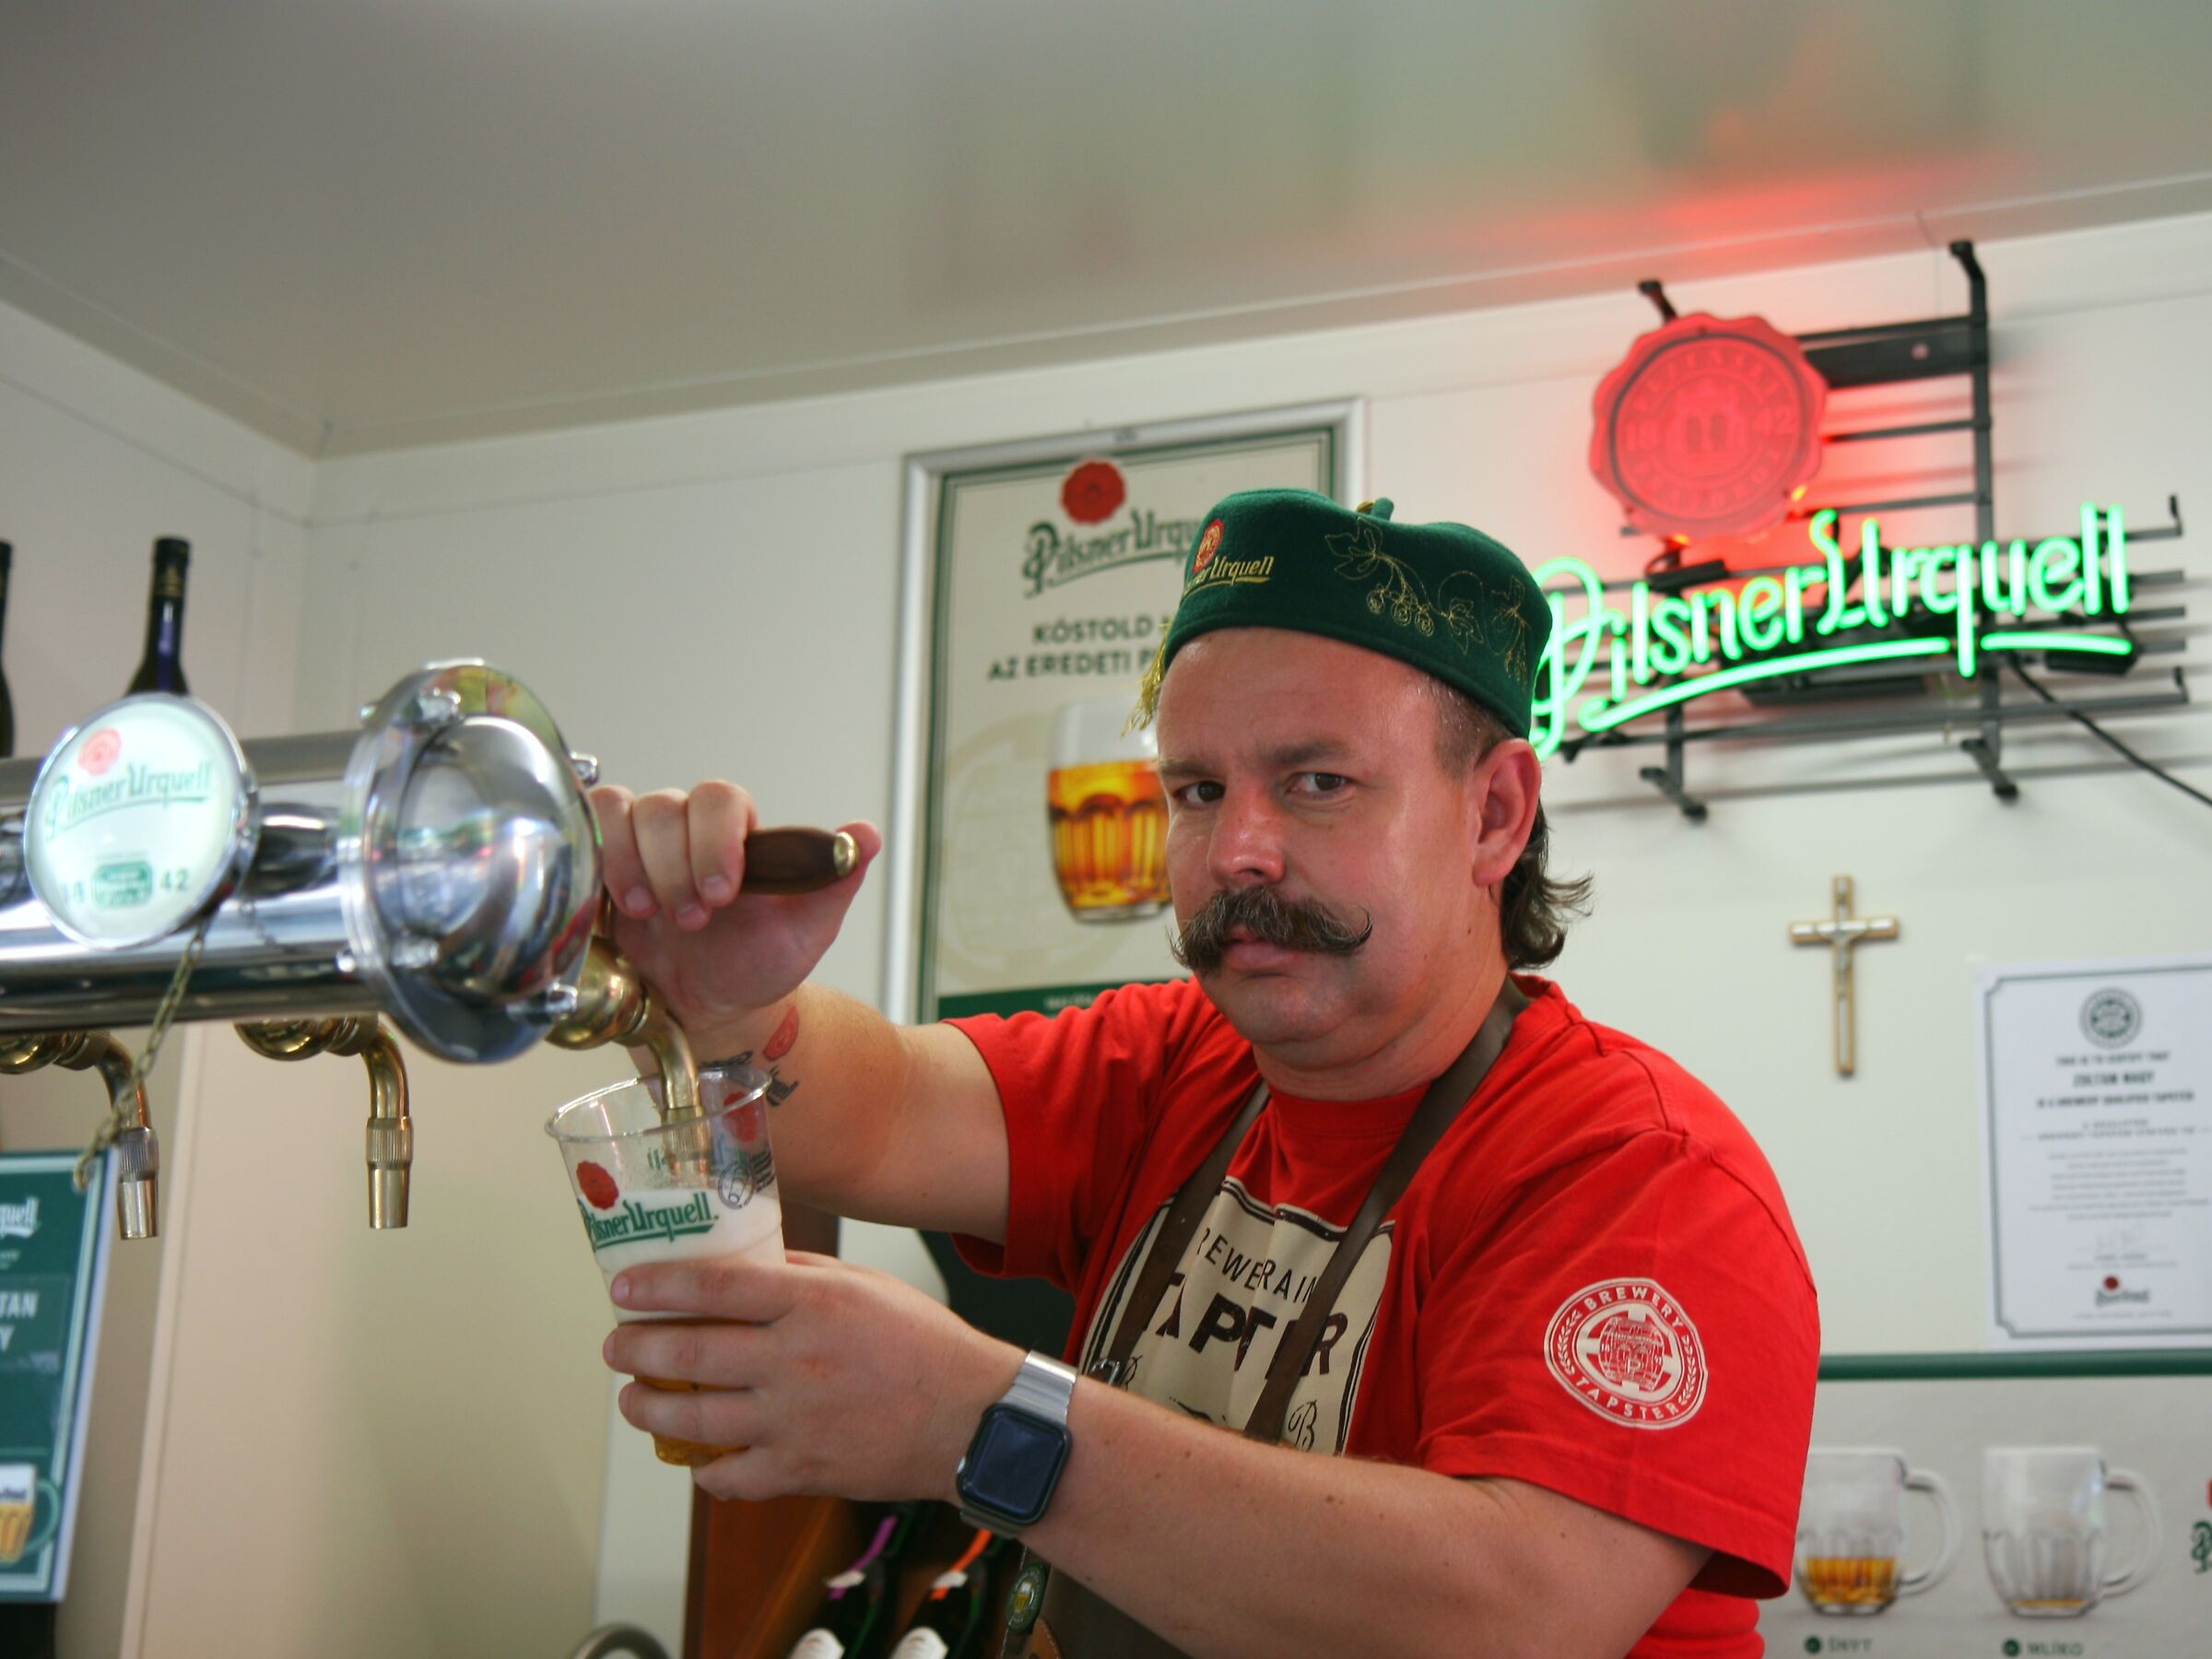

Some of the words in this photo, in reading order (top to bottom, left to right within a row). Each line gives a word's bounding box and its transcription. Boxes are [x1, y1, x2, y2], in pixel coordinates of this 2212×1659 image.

[1210, 555, 1274, 586] Urquell
[1528, 556, 1828, 761] Pilsner
[1808, 501, 2131, 677] Urquell
[989, 656, 1019, 680] AZ
[1026, 650, 1131, 677] EREDETI
[623, 1192, 714, 1242] Urquell
[1583, 1286, 1684, 1328] BREWERY
[1576, 1376, 1680, 1419] TAPSTER
